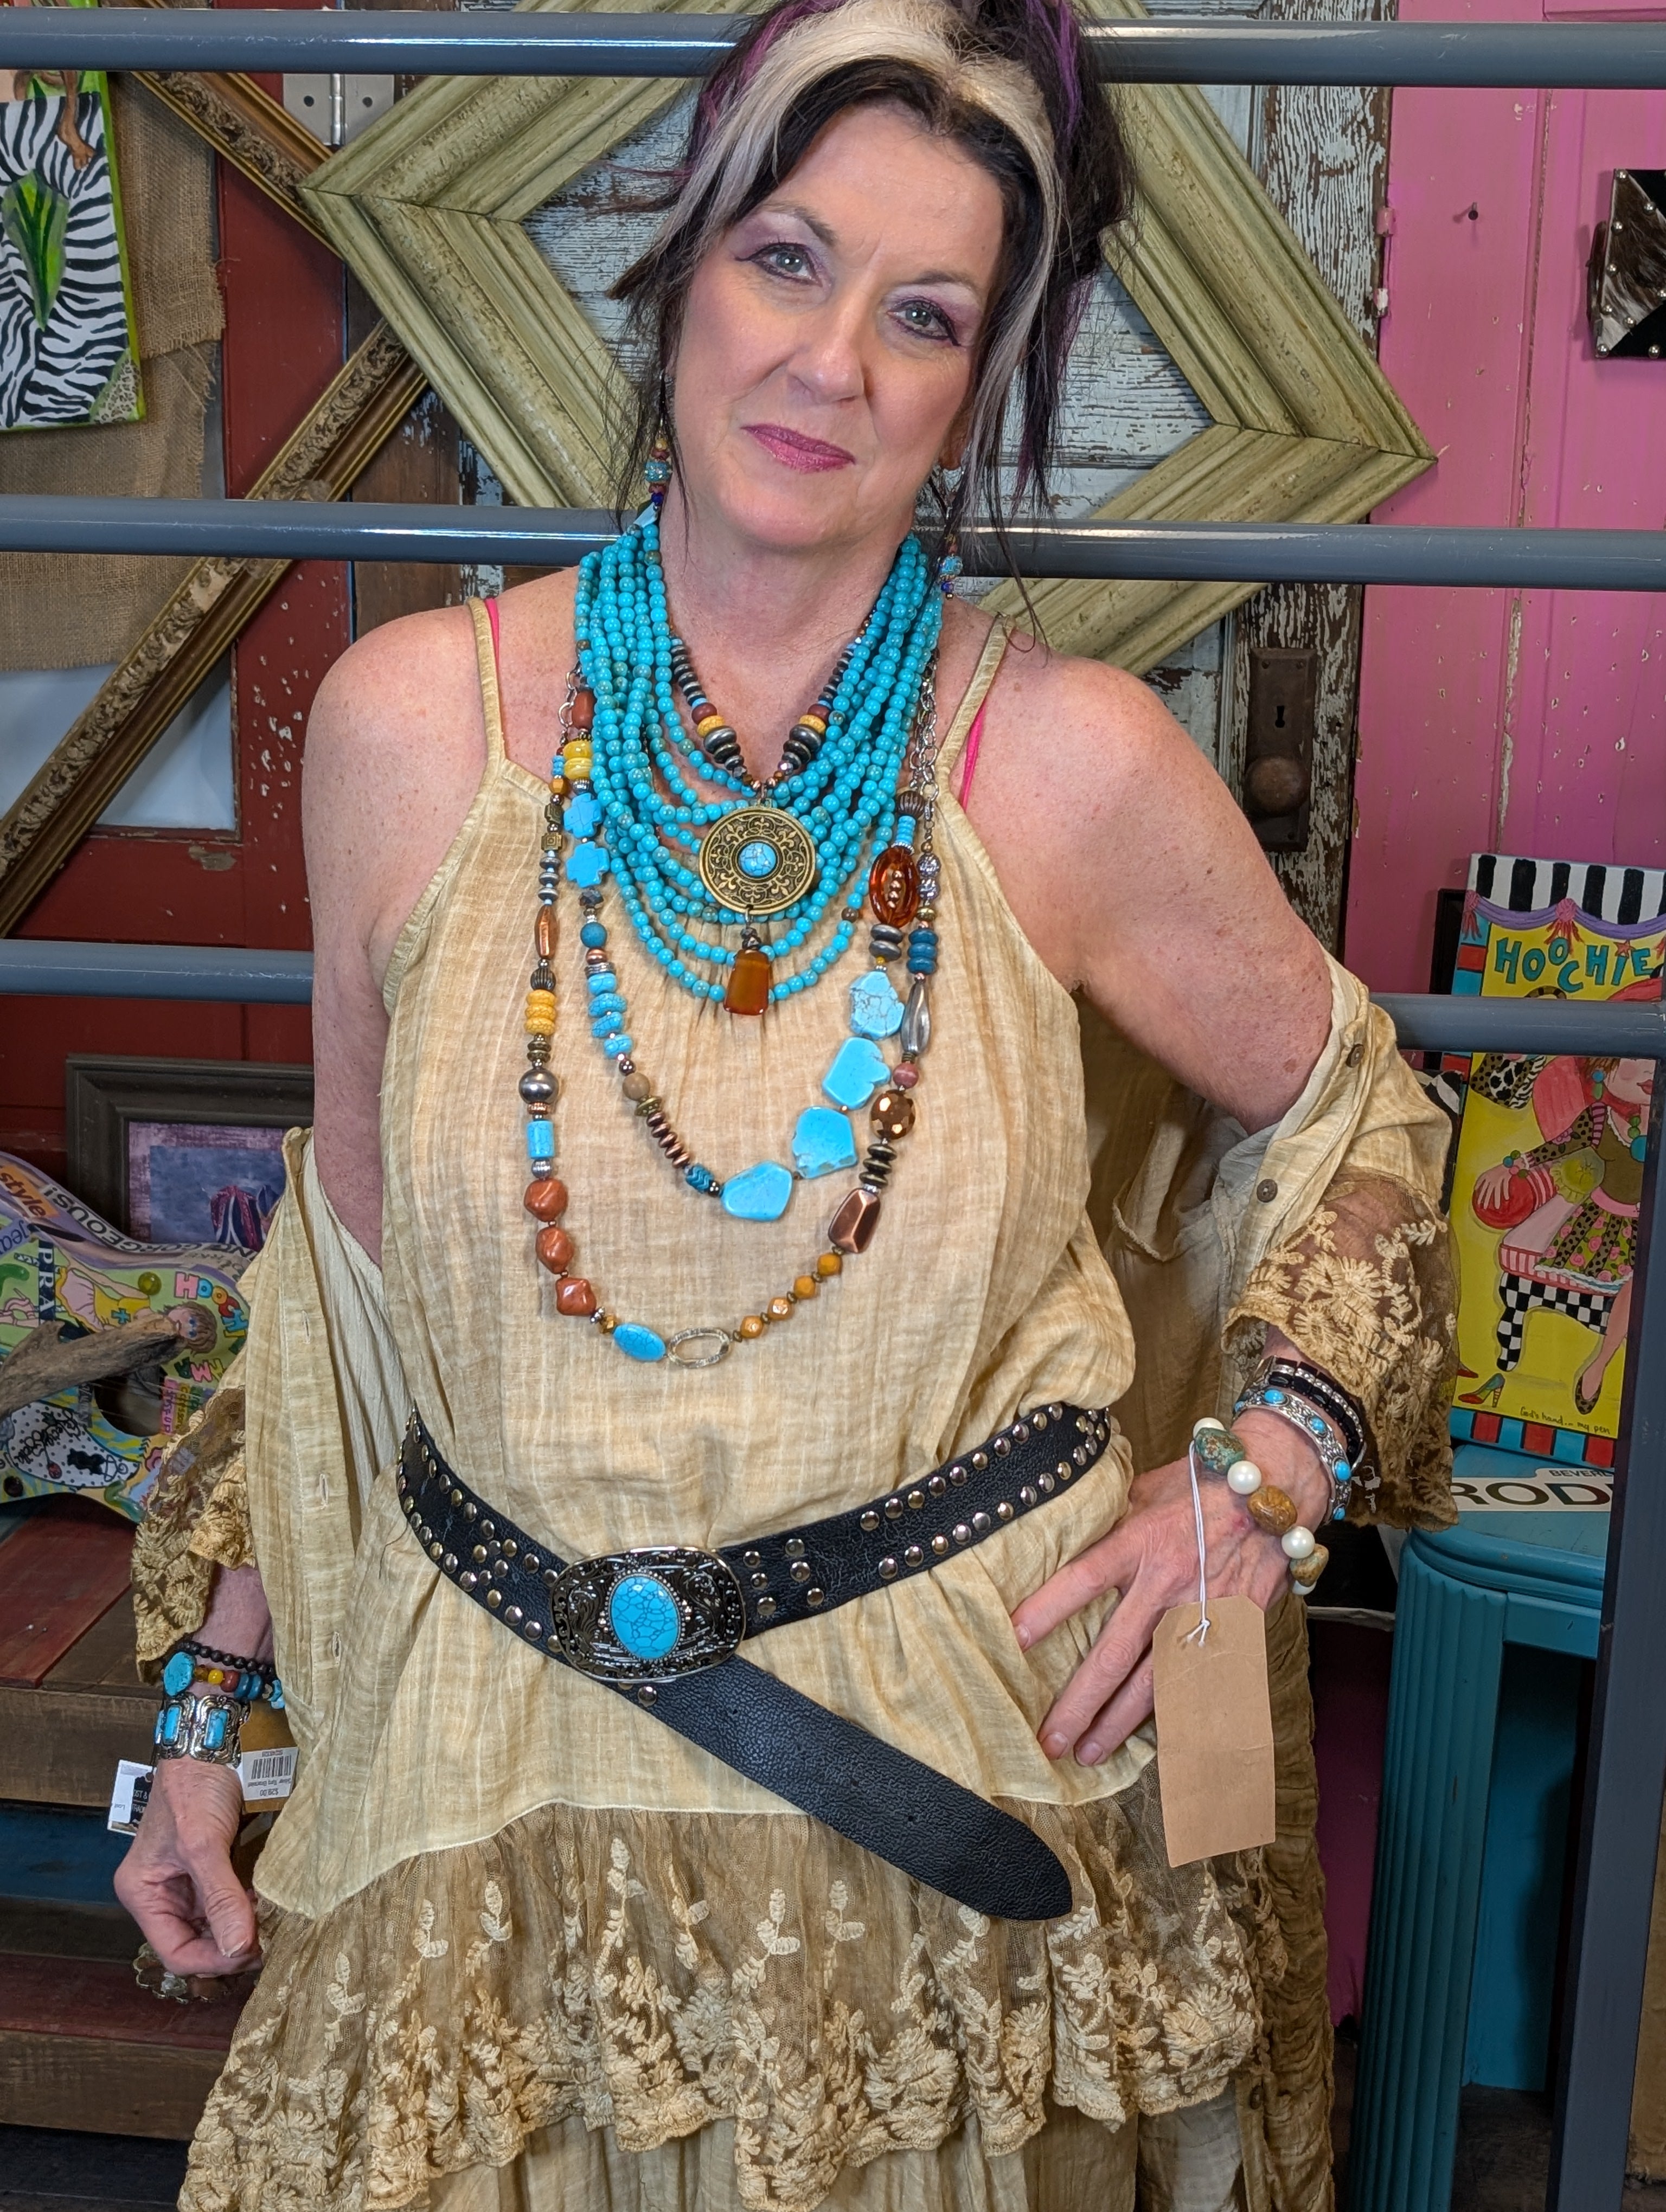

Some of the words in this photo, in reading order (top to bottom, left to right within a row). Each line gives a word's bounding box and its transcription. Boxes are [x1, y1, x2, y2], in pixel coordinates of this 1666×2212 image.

[1495, 937, 1655, 993] HOOCHIE
[43, 1187, 203, 1253] GORGEOUS!
[1593, 1425, 1610, 1435] pen
[1450, 1482, 1613, 1506] ROD
